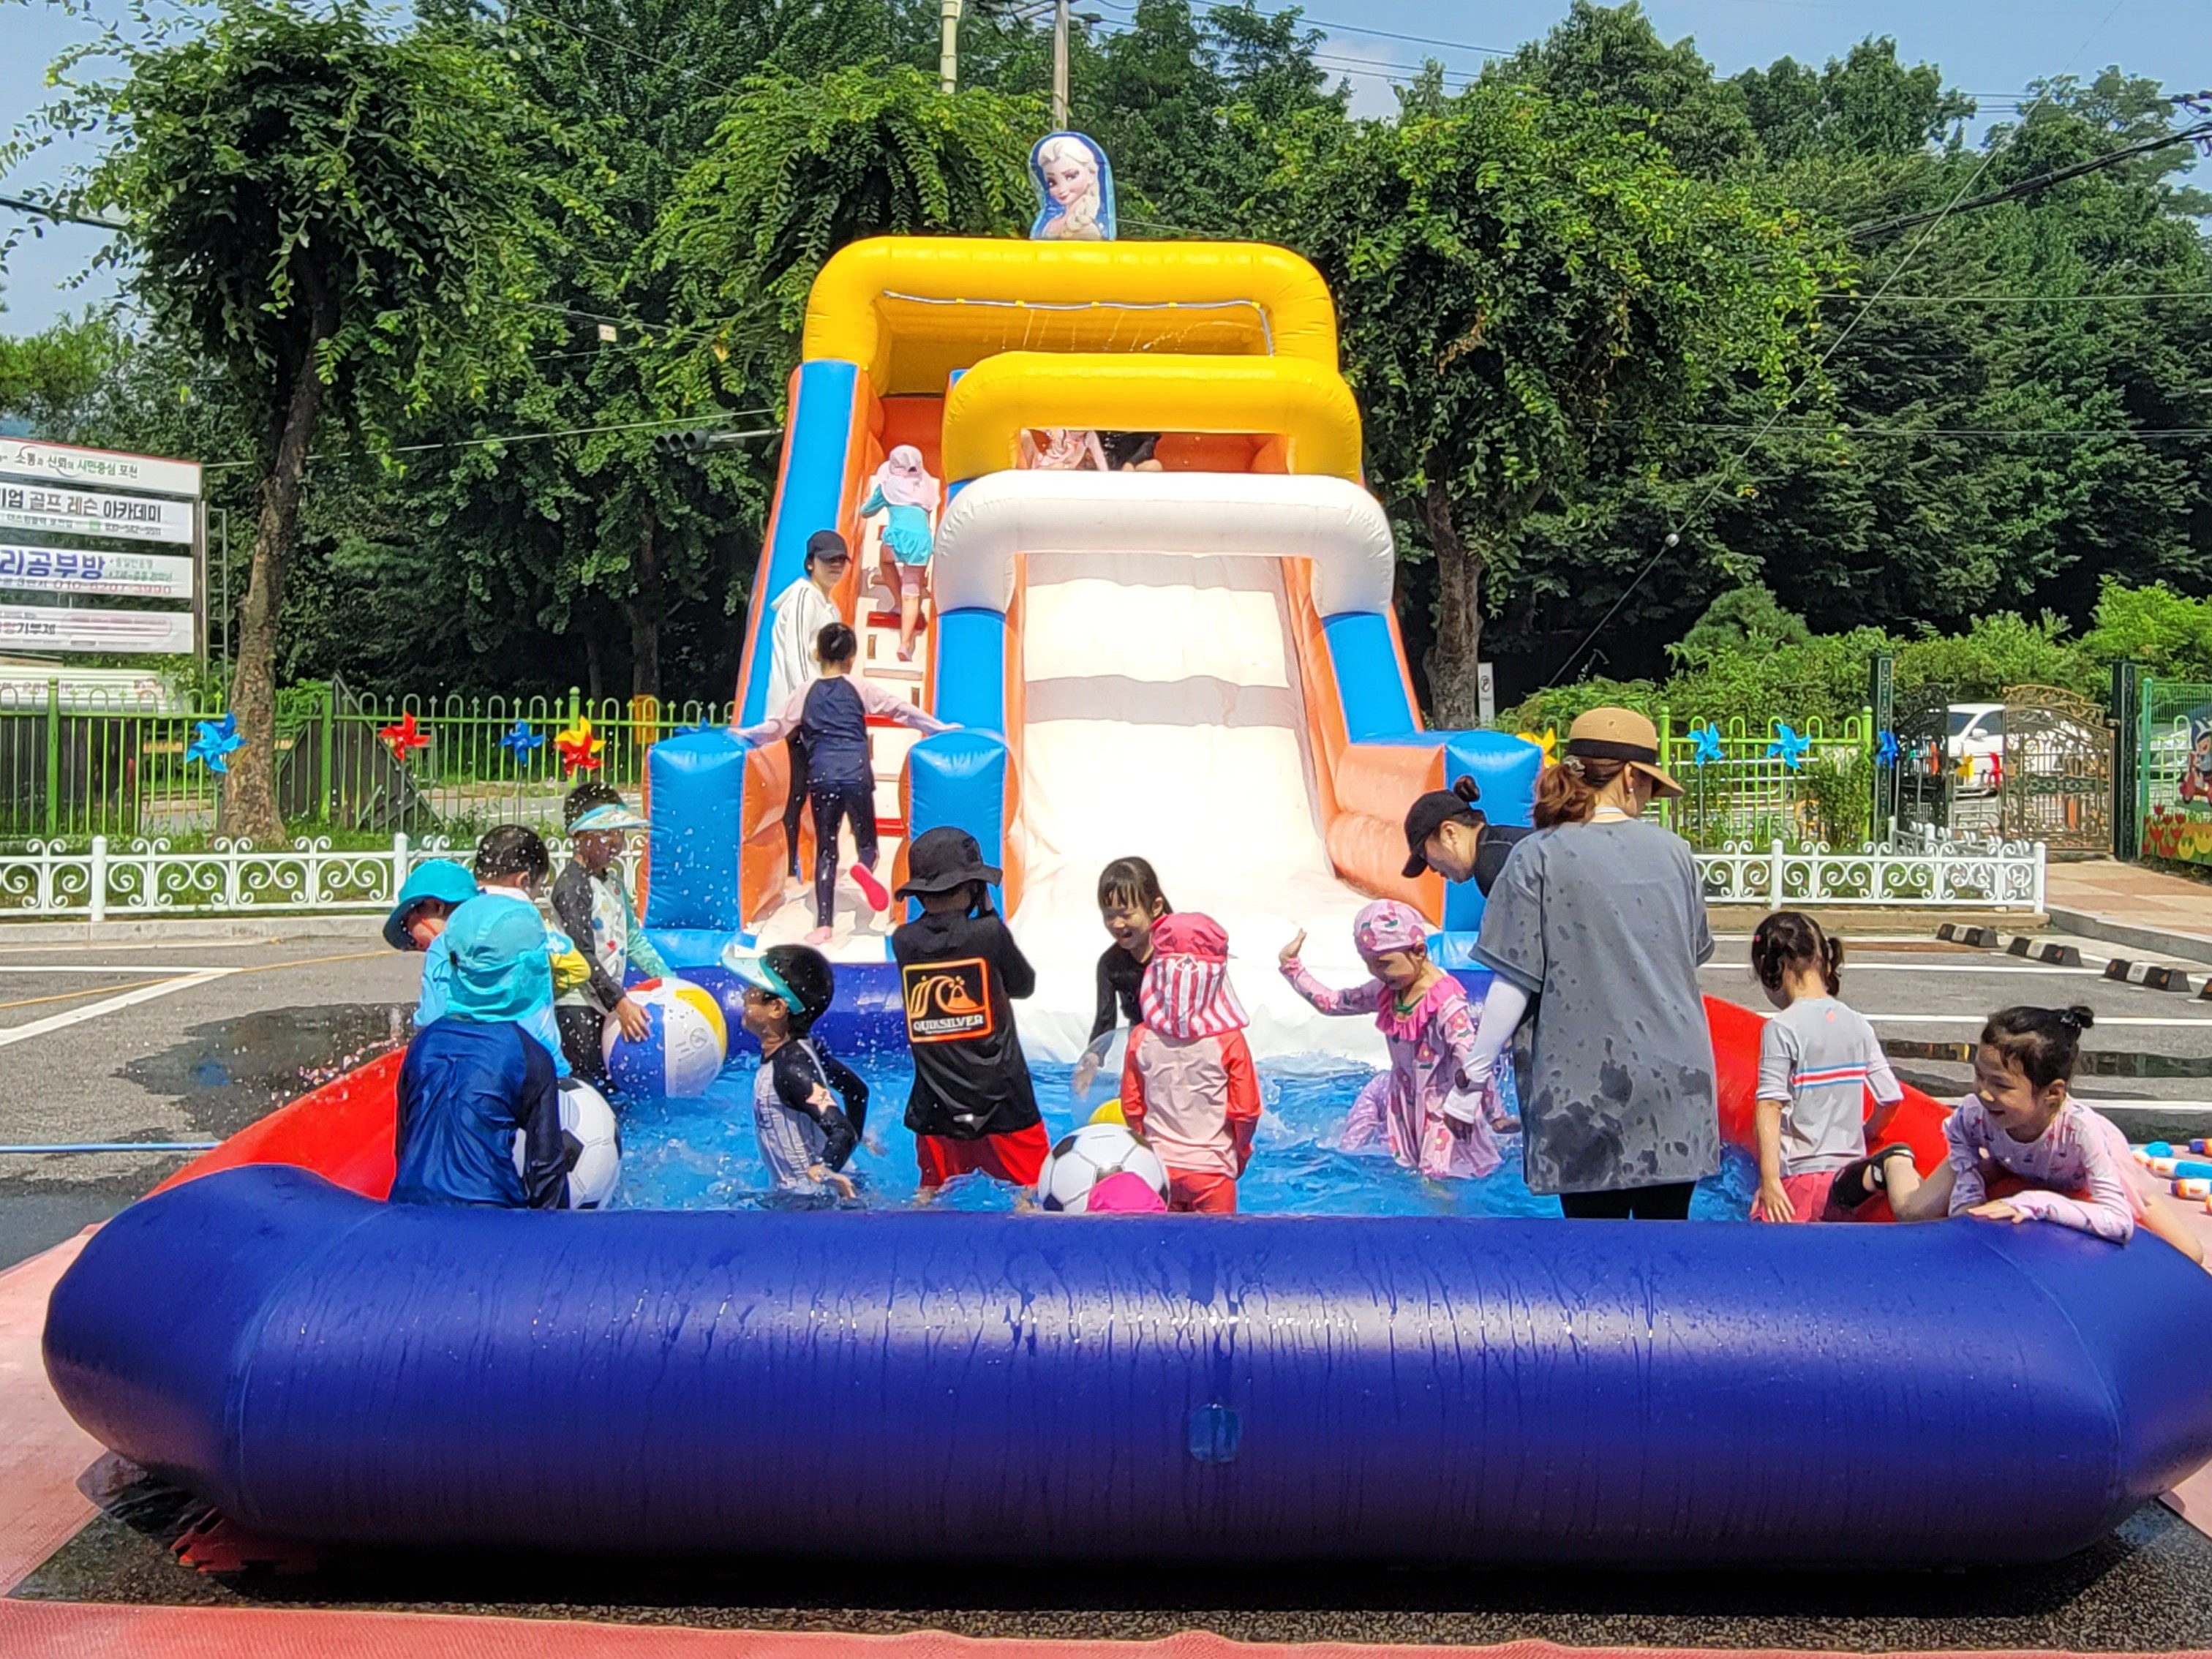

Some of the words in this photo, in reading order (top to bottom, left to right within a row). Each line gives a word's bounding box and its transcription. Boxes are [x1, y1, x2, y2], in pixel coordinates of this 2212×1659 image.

[118, 464, 138, 478] 포천
[29, 492, 61, 512] 골프
[67, 496, 98, 516] 레슨
[102, 500, 161, 522] 아카데미
